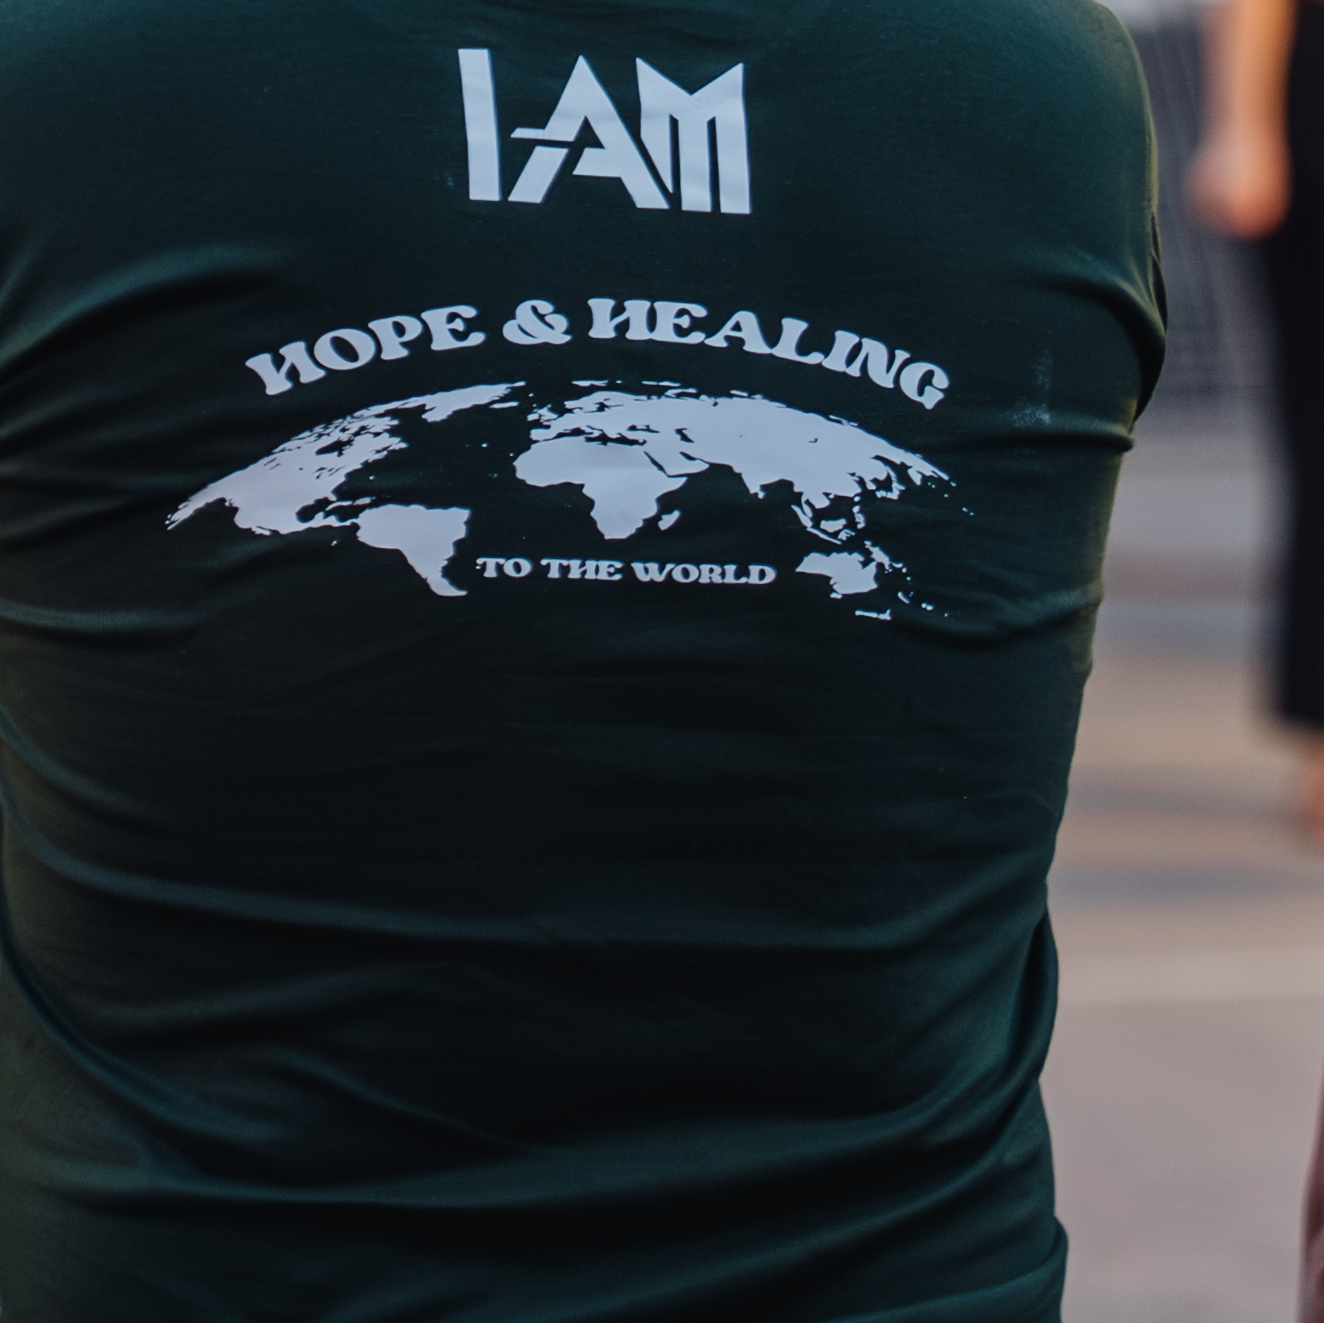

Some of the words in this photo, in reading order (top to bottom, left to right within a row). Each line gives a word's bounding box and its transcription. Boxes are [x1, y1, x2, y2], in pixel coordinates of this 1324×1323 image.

[457, 48, 502, 202] I
[506, 54, 752, 215] AM
[245, 304, 487, 396] HOPE
[501, 298, 573, 345] &
[587, 297, 950, 410] HEALING
[478, 556, 533, 578] TO
[540, 559, 623, 580] THE
[630, 563, 777, 585] WORLD
